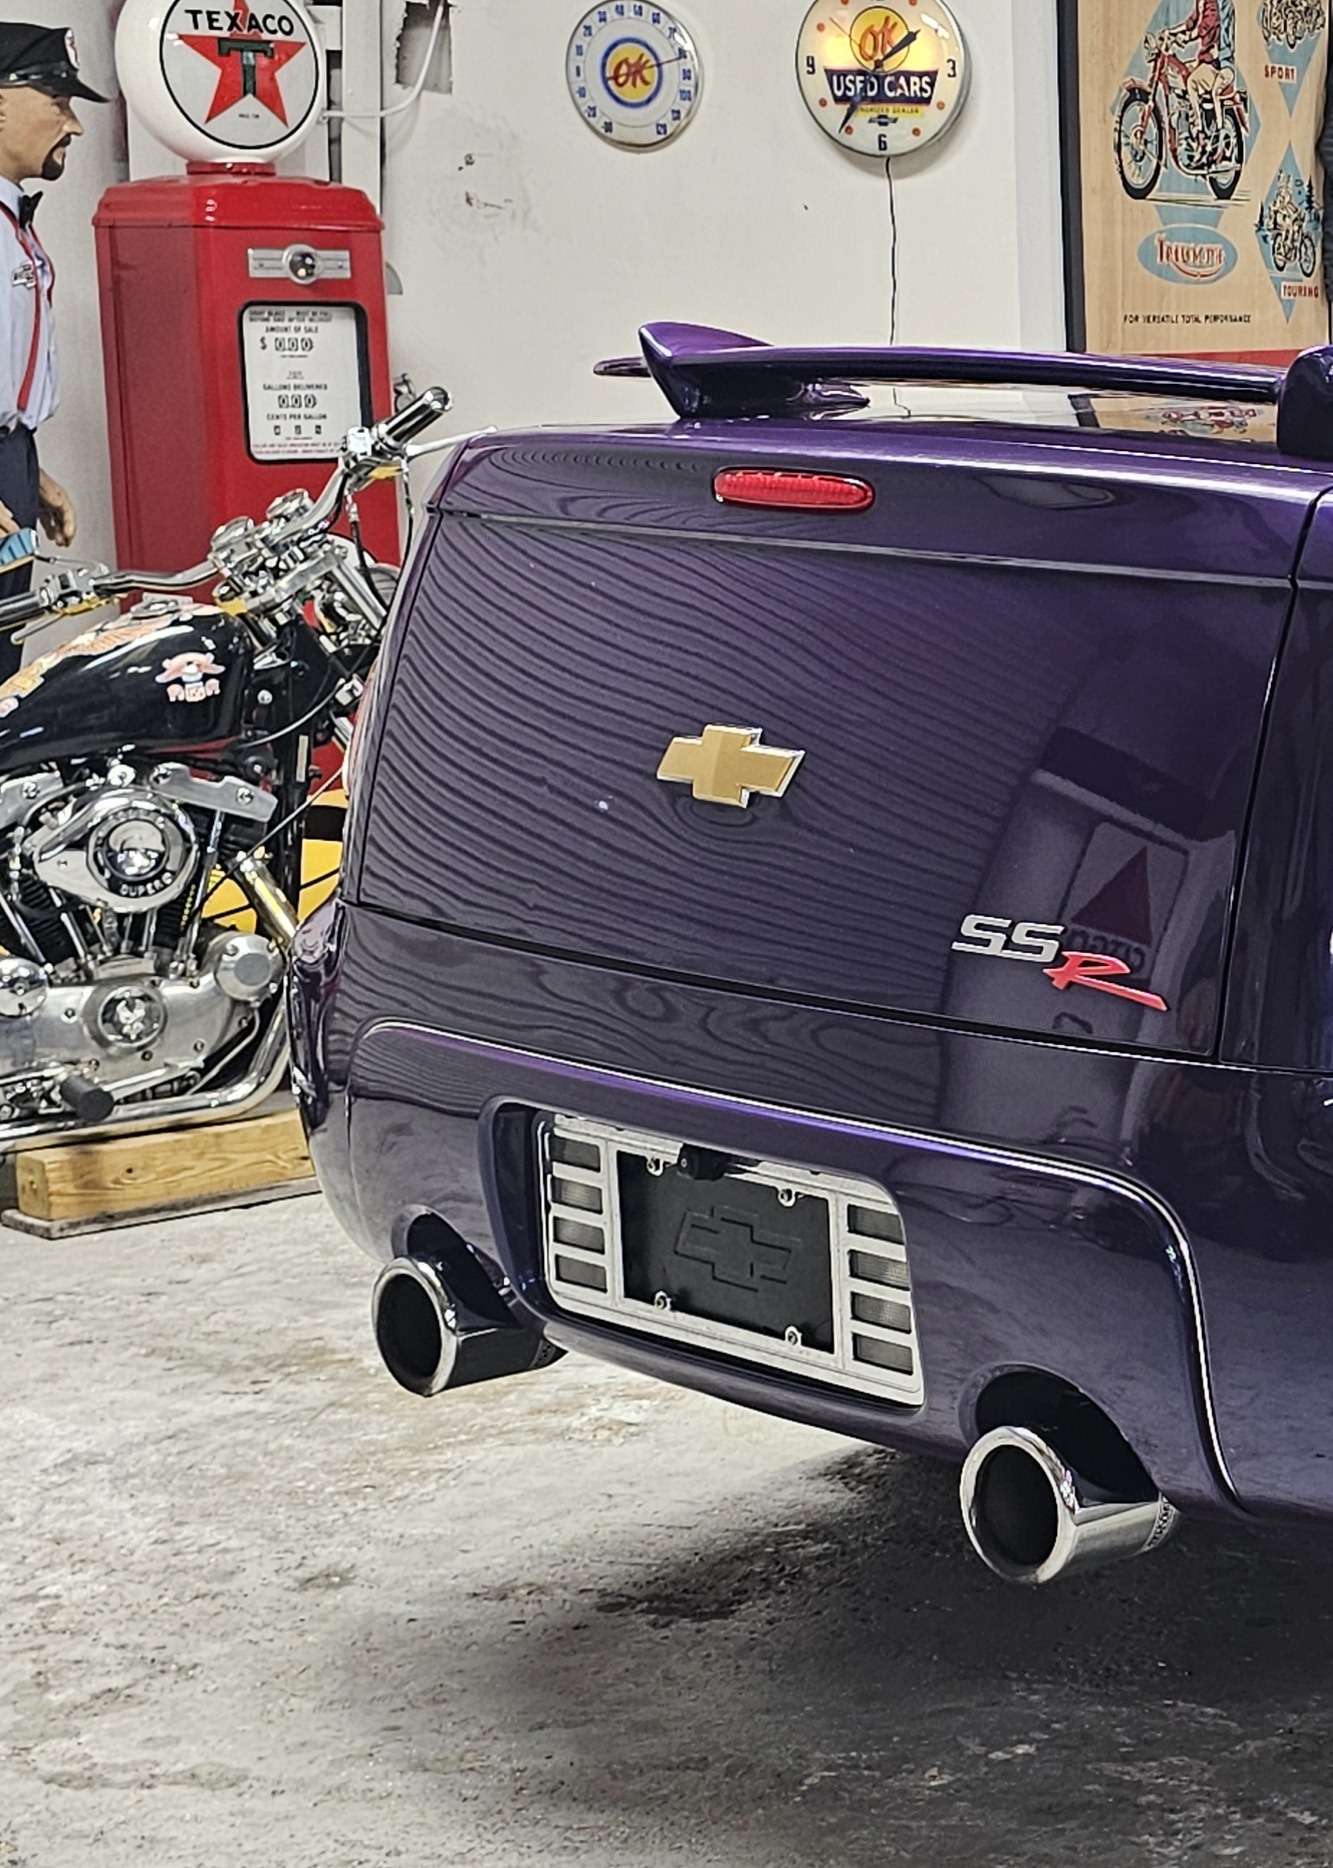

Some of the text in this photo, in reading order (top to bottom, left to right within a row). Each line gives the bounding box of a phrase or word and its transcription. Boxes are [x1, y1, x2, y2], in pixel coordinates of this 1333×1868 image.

[185, 9, 294, 36] TEXACO
[859, 15, 899, 62] OK
[612, 52, 652, 89] OK
[805, 55, 816, 75] 9
[946, 58, 957, 78] 3
[1264, 65, 1295, 80] SPORT
[832, 74, 932, 98] USED CARS
[877, 133, 888, 151] 6
[1154, 233, 1226, 273] TRIUMPH
[1283, 284, 1320, 299] TOURING
[1123, 314, 1140, 324] FOR
[1182, 314, 1202, 324] TOTAL
